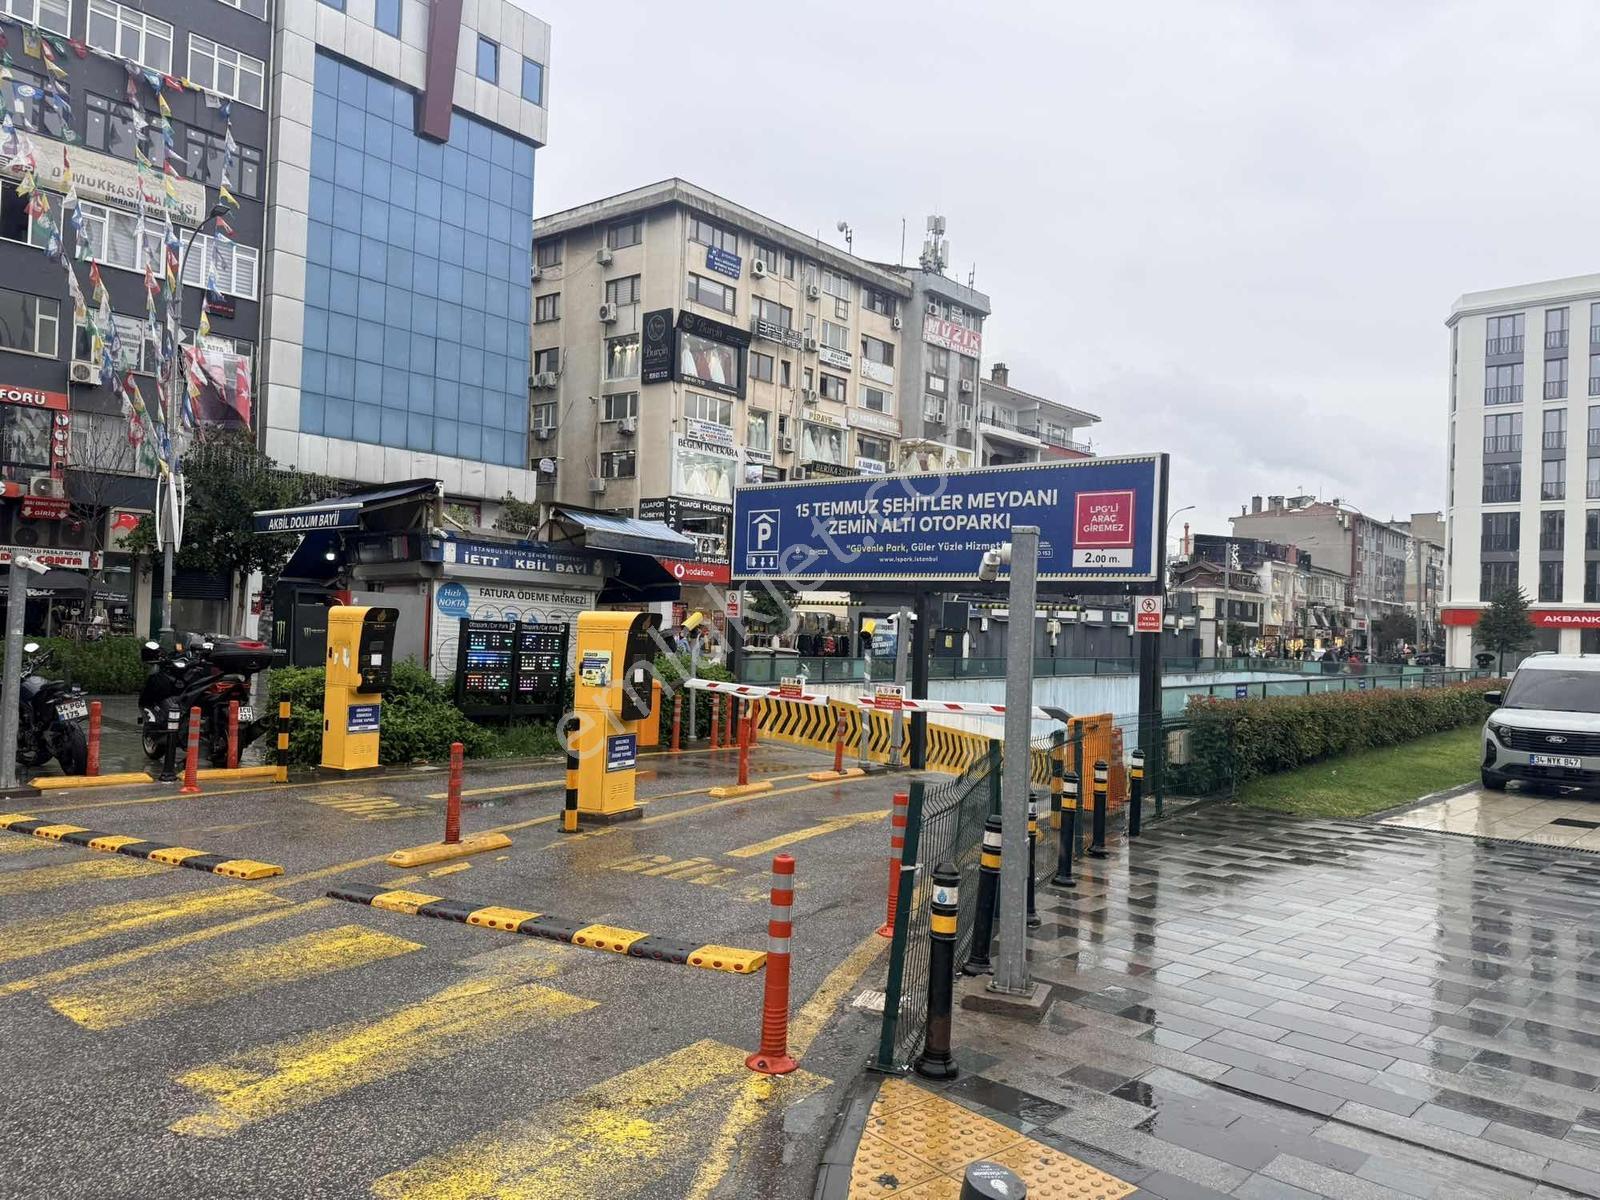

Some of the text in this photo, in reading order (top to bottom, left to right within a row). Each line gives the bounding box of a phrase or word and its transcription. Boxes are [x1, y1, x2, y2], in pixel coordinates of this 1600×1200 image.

[640, 501, 665, 509] KUAFÖR
[679, 501, 733, 514] KUAFÖR HÜSEYİN
[795, 488, 1059, 517] 15 TEMMUZ ŞEHİTLER MEYDANI
[268, 510, 340, 530] AKBİL DOLUM BAYİİ
[640, 511, 665, 519] HÜSEYİN
[1090, 514, 1118, 525] ARAÇ
[828, 512, 1012, 535] ZEMİN ALTI OTOPARKI
[1082, 523, 1125, 533] GİREMEZ
[470, 545, 502, 555] İSTANBUL
[504, 549, 526, 557] BÜYÜK
[885, 542, 909, 554] Park,
[910, 541, 936, 553] Güler
[937, 540, 963, 552] Yüzle
[36, 555, 82, 566] ÇANTA
[463, 551, 587, 575] İETT KBİL BAYİ
[1084, 552, 1107, 564] 2.00
[685, 568, 714, 577] vodafone
[480, 587, 587, 605] FATURA ÖDEME MERKEZİ
[439, 599, 467, 609] NOKTA
[1543, 615, 1600, 623] AKBANK
[57, 704, 68, 713] 34
[66, 710, 80, 719] 175
[1536, 755, 1545, 763] 34
